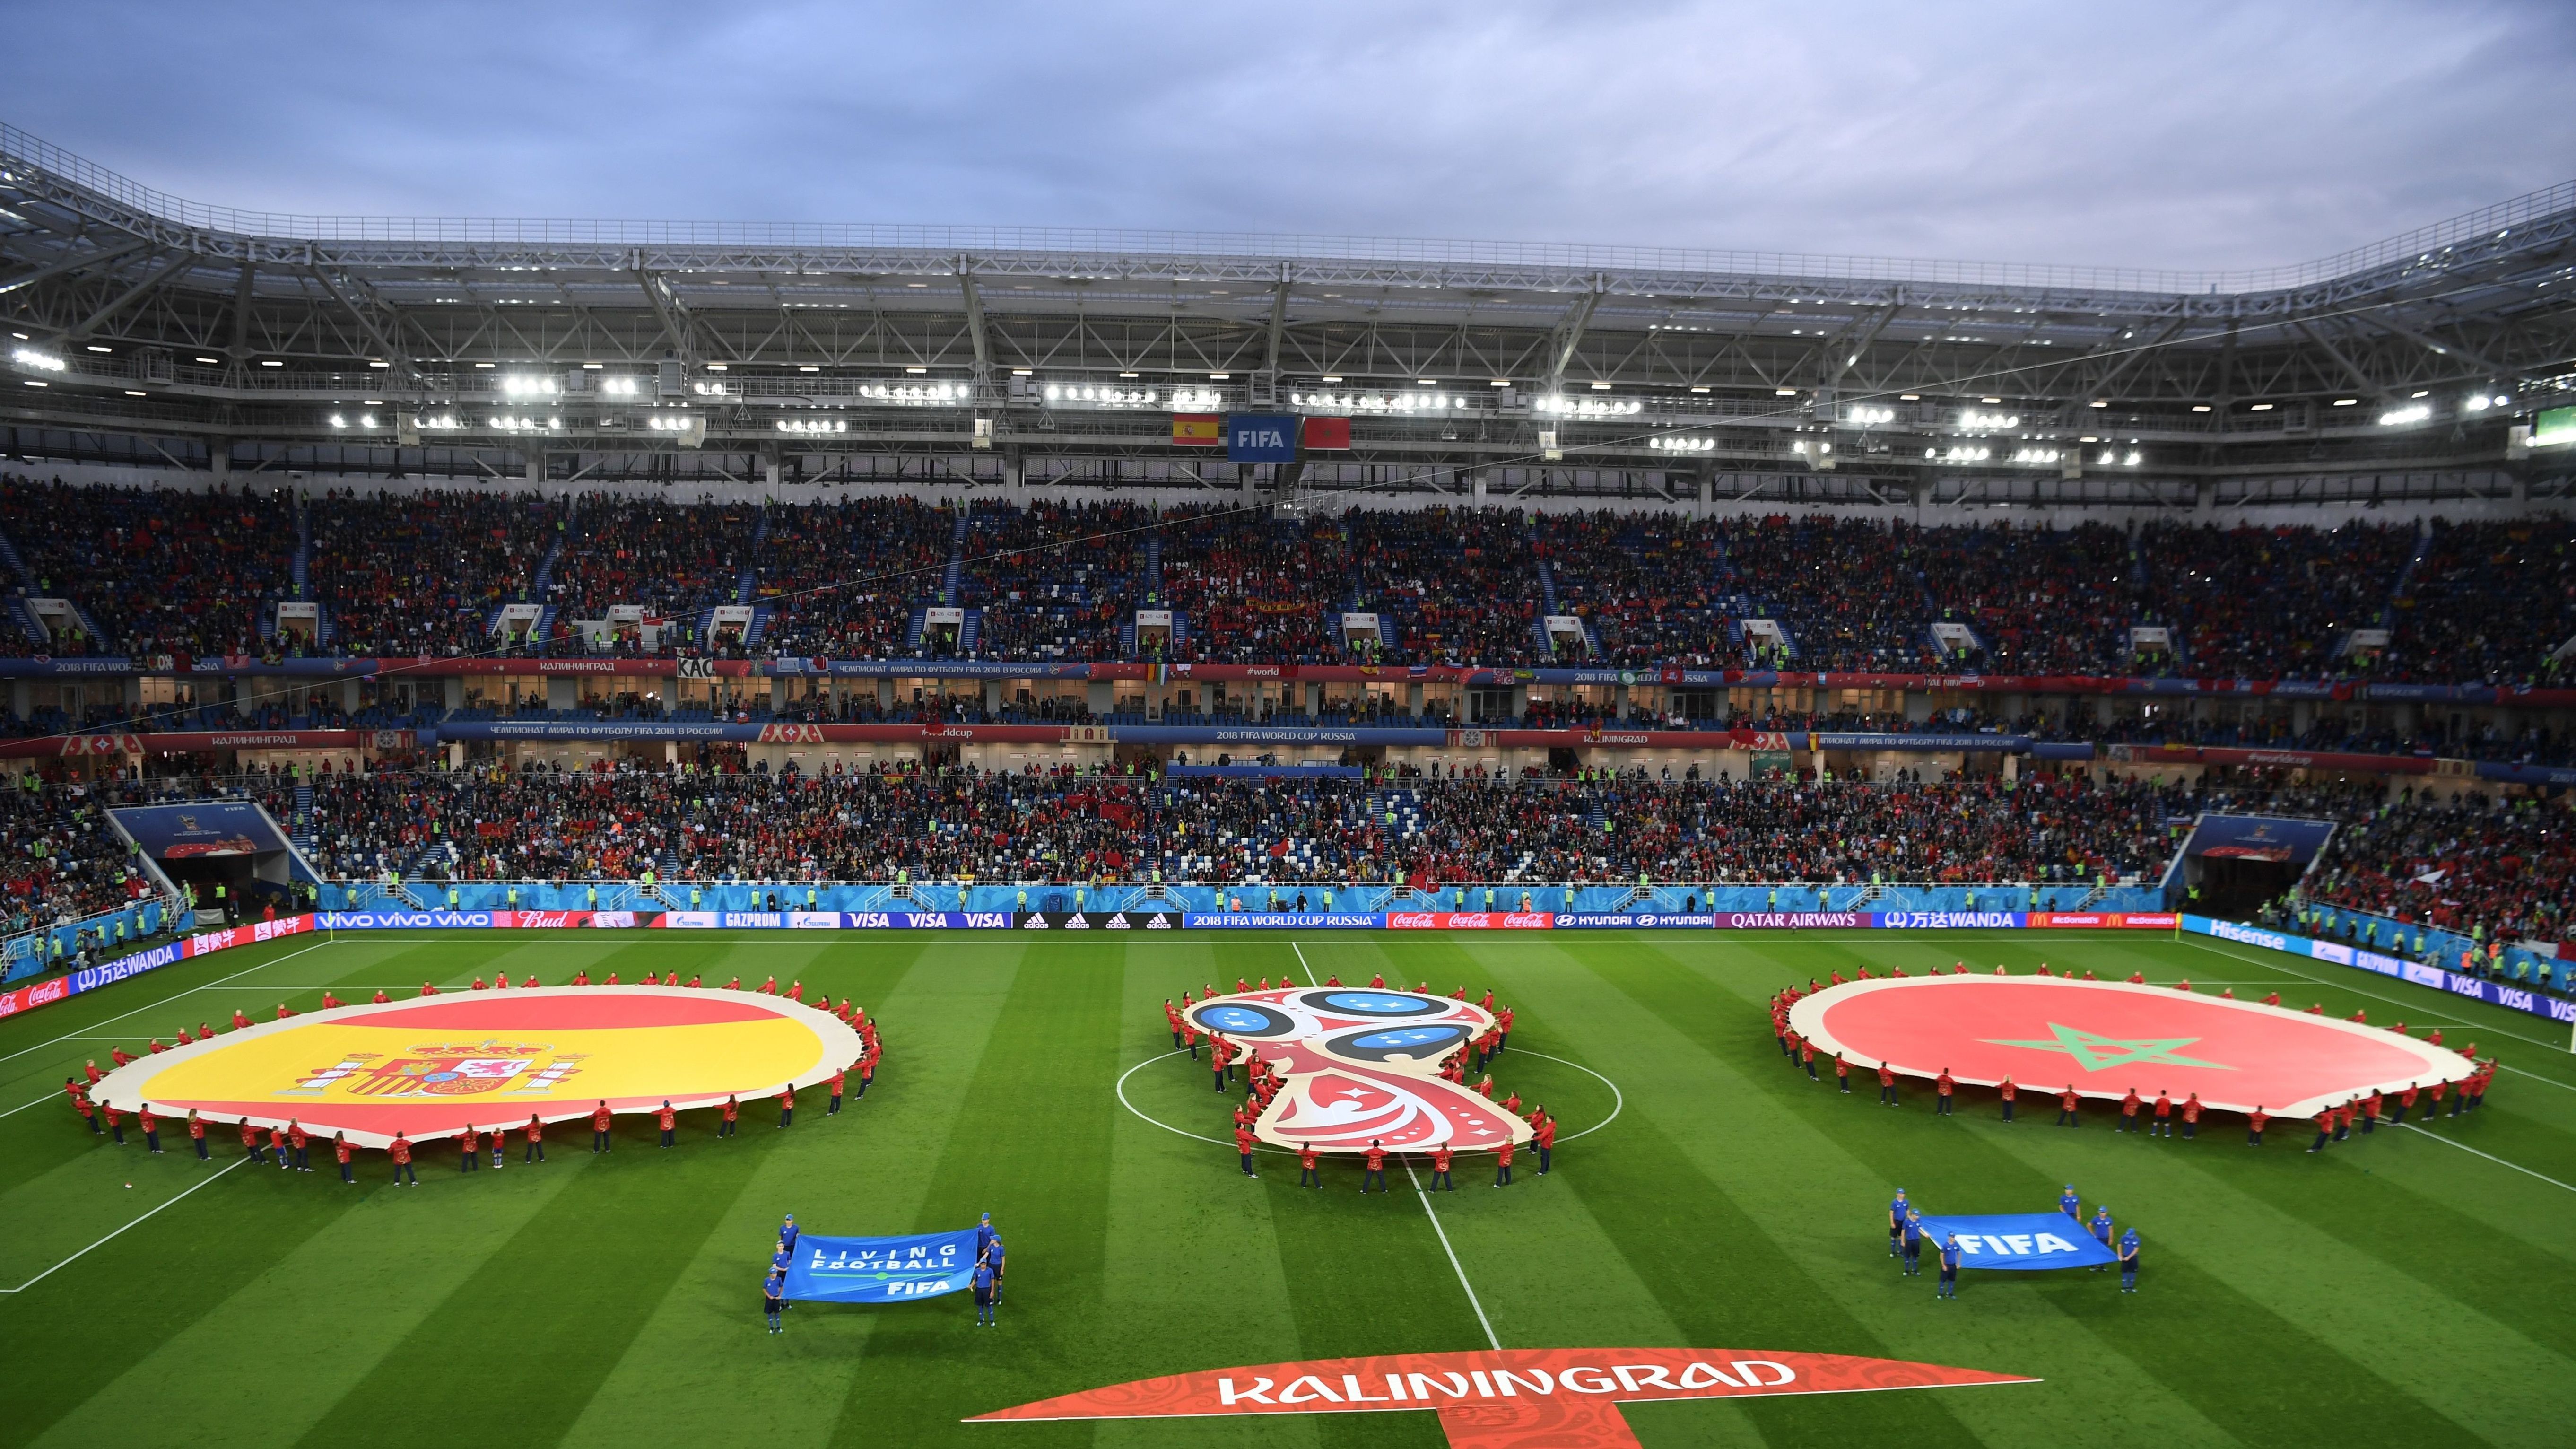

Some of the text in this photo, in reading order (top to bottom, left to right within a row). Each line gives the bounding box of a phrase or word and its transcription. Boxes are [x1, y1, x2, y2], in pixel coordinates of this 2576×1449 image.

[1238, 431, 1284, 448] FIFA
[55, 663, 81, 672] 2018
[83, 663, 104, 672] FIFA
[540, 662, 615, 671] КАЛИНИНГРАД
[1247, 667, 1279, 676] #world
[548, 726, 574, 734] МИРА
[591, 727, 632, 735] ФУТБОЛУ
[1217, 731, 1237, 739] 2018
[212, 735, 296, 745] КАЛИНИНГРАД
[319, 912, 489, 927] vivo vivo vivo
[518, 911, 568, 927] Bud
[726, 913, 780, 927] GAZPROM
[847, 913, 1004, 927] VISA VISA VISA
[1193, 916, 1221, 925] 2018
[1224, 916, 1250, 925] FIFA
[1252, 916, 1296, 925] WORLD
[1298, 916, 1324, 925] CUP
[1578, 916, 1632, 925] HYUNDAI
[1660, 916, 1713, 925] HYUNDAI
[1731, 913, 1856, 928] QATAR AIRWAYS
[2126, 917, 2175, 925] McDonald's
[2210, 918, 2286, 950] Hisense
[2447, 974, 2576, 1022] VISA VISA VIS
[1955, 1232, 2079, 1255] FIFA
[814, 1243, 956, 1260] LIVING
[887, 1281, 950, 1295] FIFA
[1218, 1360, 1797, 1405] KALININGRAD
